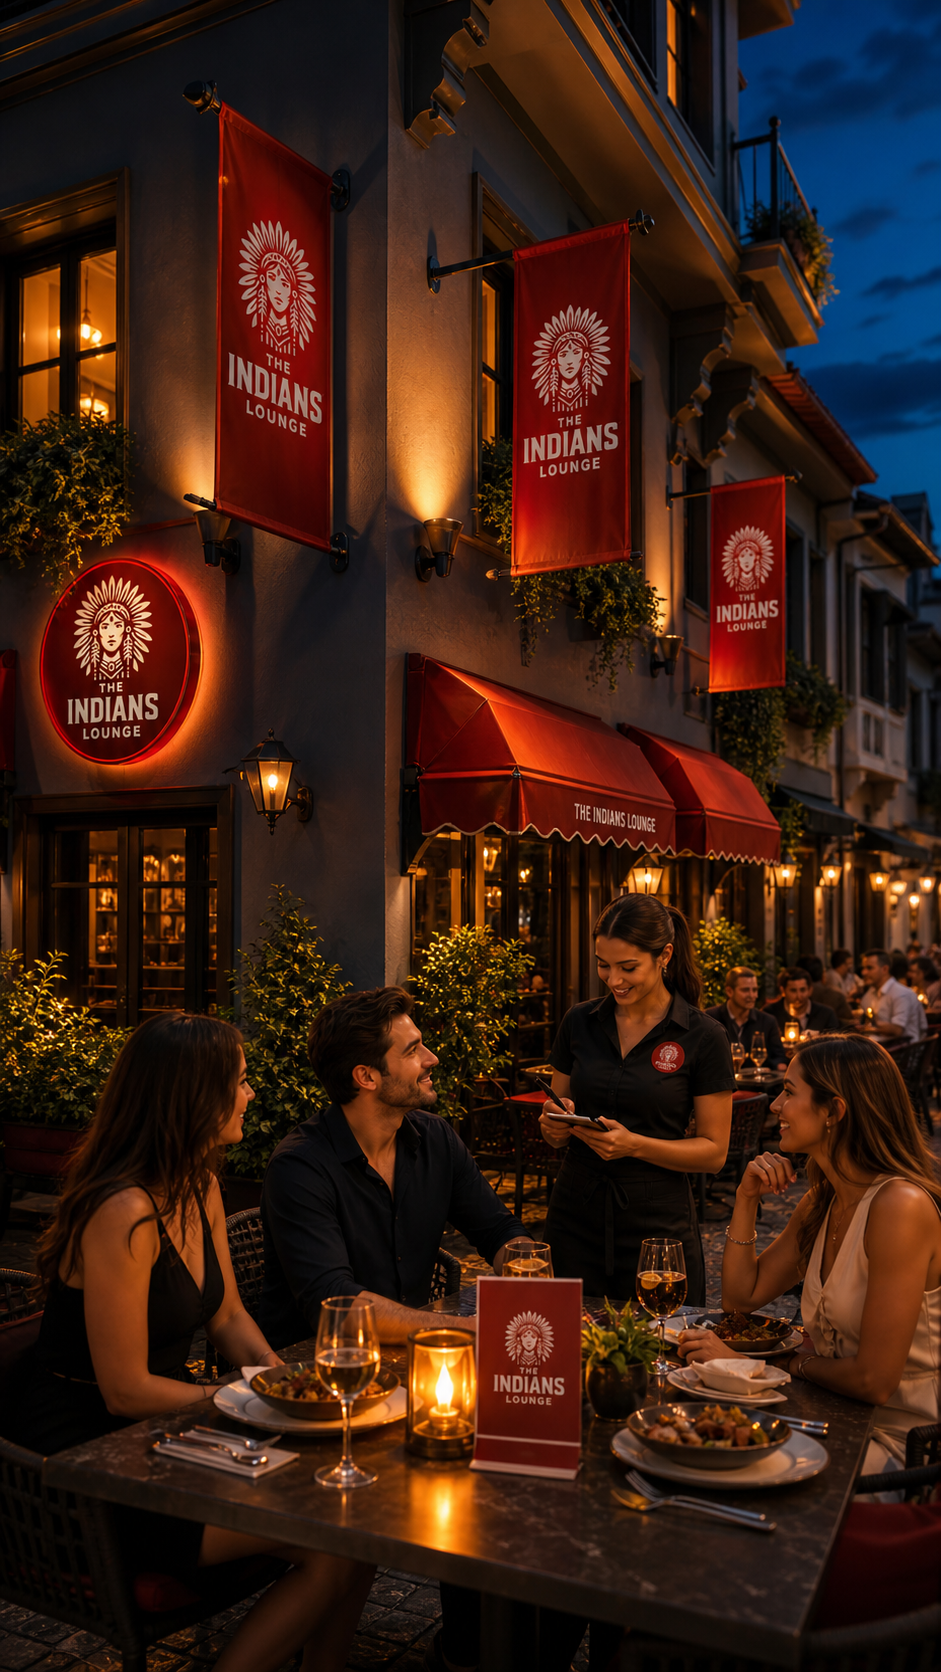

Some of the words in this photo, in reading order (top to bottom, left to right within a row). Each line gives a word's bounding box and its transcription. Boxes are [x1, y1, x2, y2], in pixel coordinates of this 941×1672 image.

[266, 353, 291, 375] THE
[227, 352, 323, 424] INDIANS
[246, 399, 307, 437] LOUNGE
[557, 414, 582, 428] THE
[523, 421, 619, 464] INDIANS
[540, 457, 601, 478] LOUNGE
[739, 593, 756, 601] THE
[716, 599, 779, 623] INDIANS
[727, 620, 767, 632] LOUNGE
[99, 681, 124, 693] THE
[67, 692, 159, 725] INDIANS
[83, 725, 141, 740] LOUNGE
[574, 803, 591, 821] THE
[592, 806, 626, 828] INDIANS
[627, 813, 656, 833] LOUNGE
[519, 1366, 539, 1375] THE
[493, 1374, 565, 1396] INDIANS
[505, 1395, 552, 1406] LOUNGE
